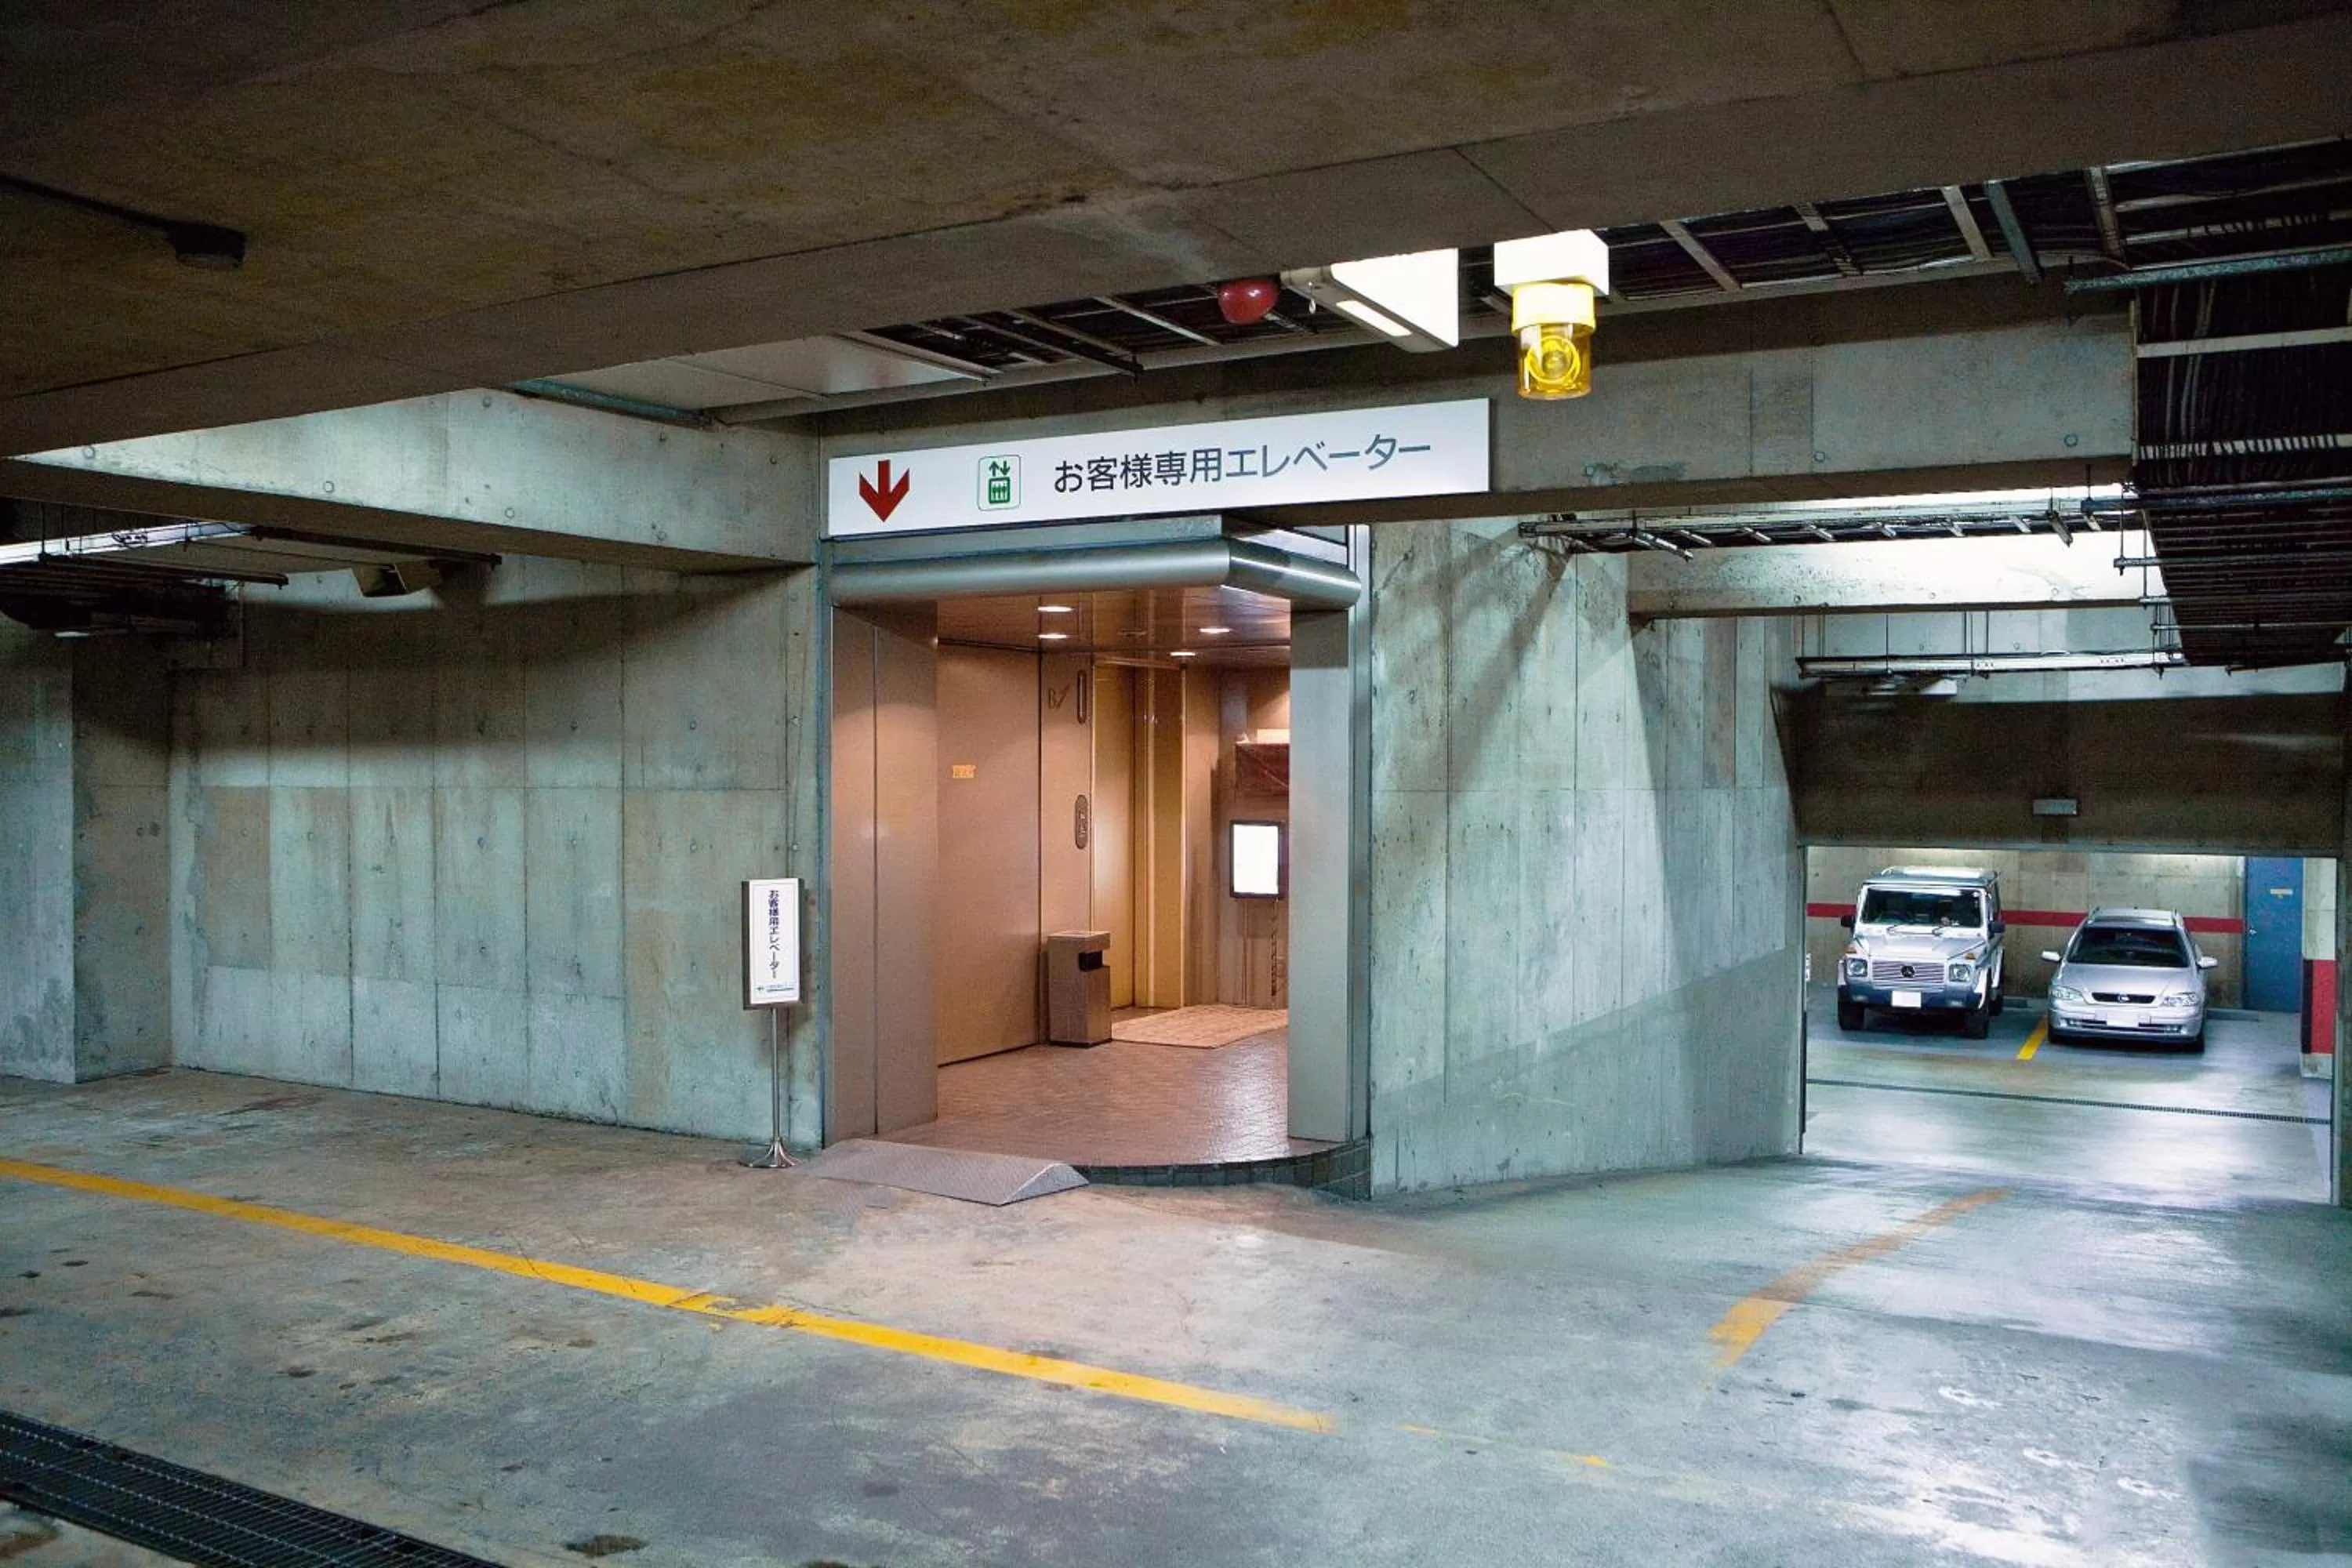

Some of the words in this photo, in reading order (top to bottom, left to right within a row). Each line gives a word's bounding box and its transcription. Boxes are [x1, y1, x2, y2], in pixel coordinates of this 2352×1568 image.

[1054, 434, 1431, 493] お客様専用エレベーター
[768, 890, 780, 978] お客様用エレベーター
